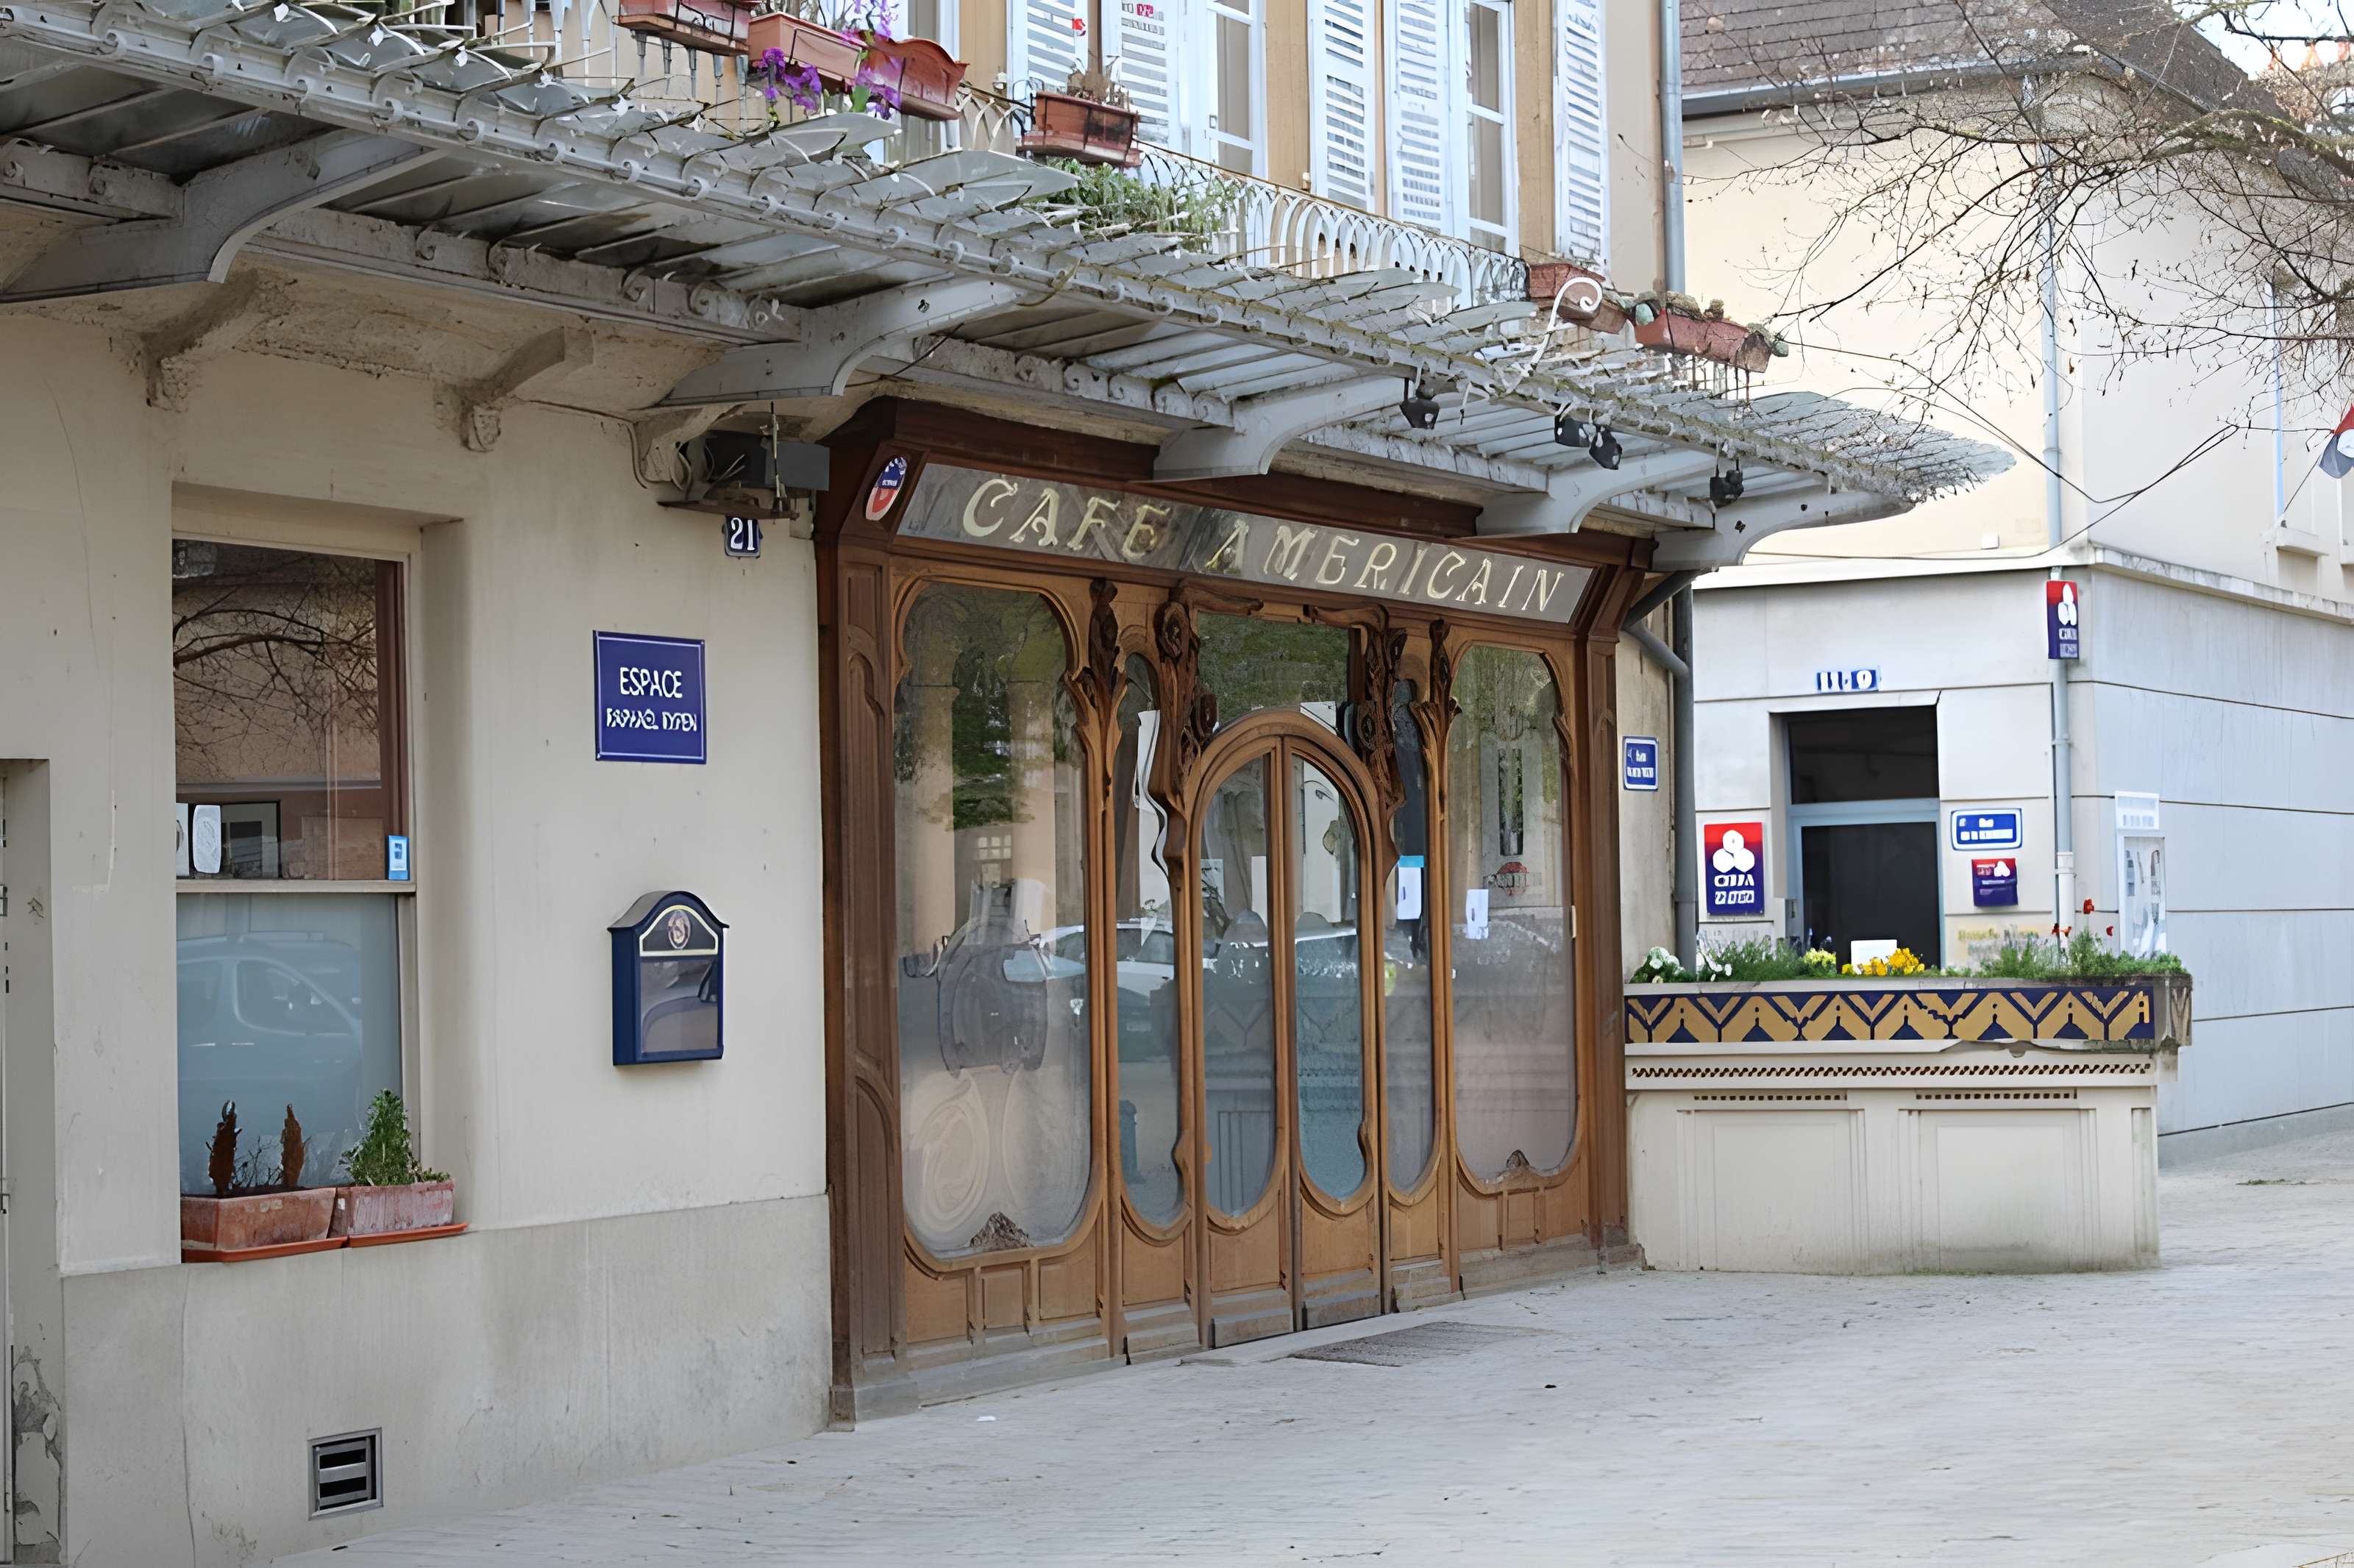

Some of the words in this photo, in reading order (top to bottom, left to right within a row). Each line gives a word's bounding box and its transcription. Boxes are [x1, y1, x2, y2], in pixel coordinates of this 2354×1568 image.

[730, 517, 755, 551] 21
[962, 477, 1171, 560] CAFE
[1204, 518, 1565, 613] AMERICAIN
[619, 666, 683, 699] ESPACE
